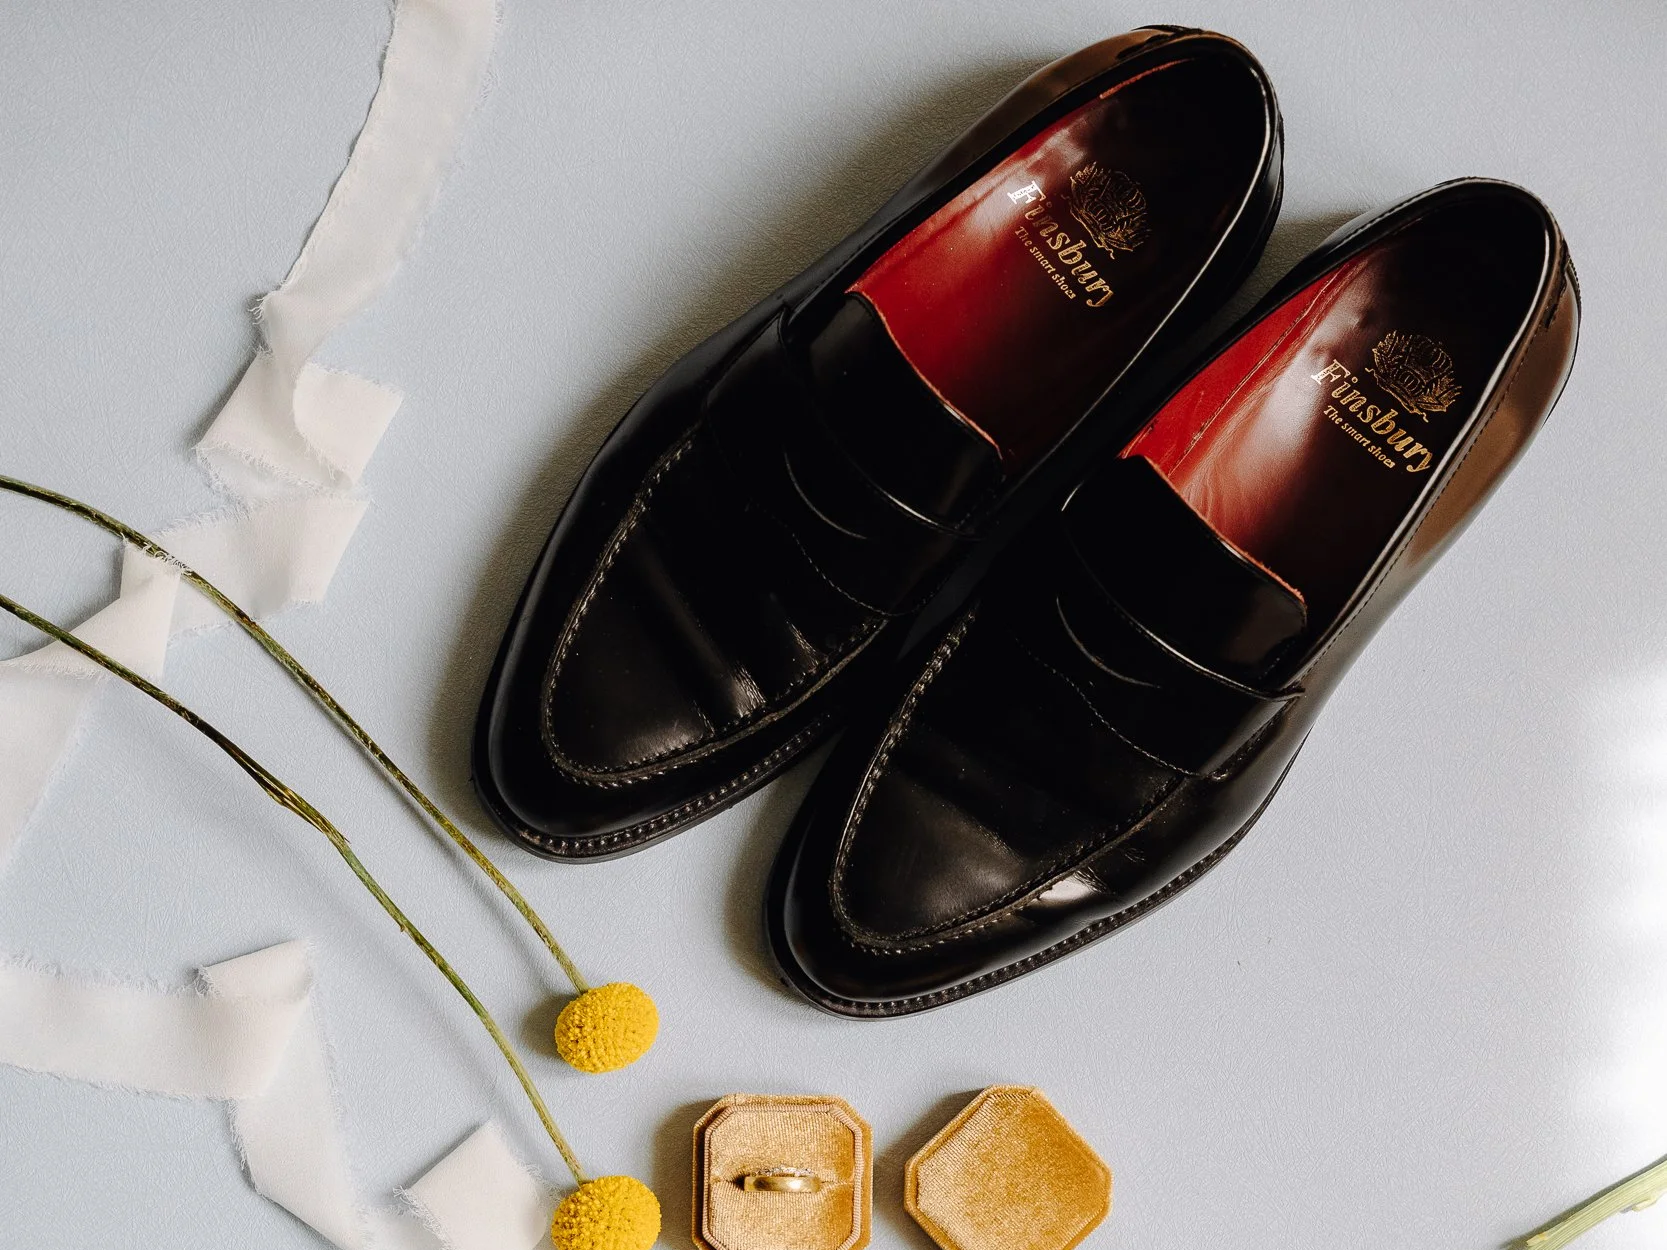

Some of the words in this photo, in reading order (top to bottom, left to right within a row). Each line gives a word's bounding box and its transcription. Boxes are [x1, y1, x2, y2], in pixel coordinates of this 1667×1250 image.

[1007, 180, 1114, 307] Finsbury
[1014, 226, 1032, 247] The
[1029, 246, 1056, 274] smart
[1052, 273, 1077, 299] shoes
[1311, 359, 1433, 473] Finsbury
[1323, 405, 1343, 425] The
[1341, 422, 1371, 447] smart
[1367, 445, 1396, 469] shoes
